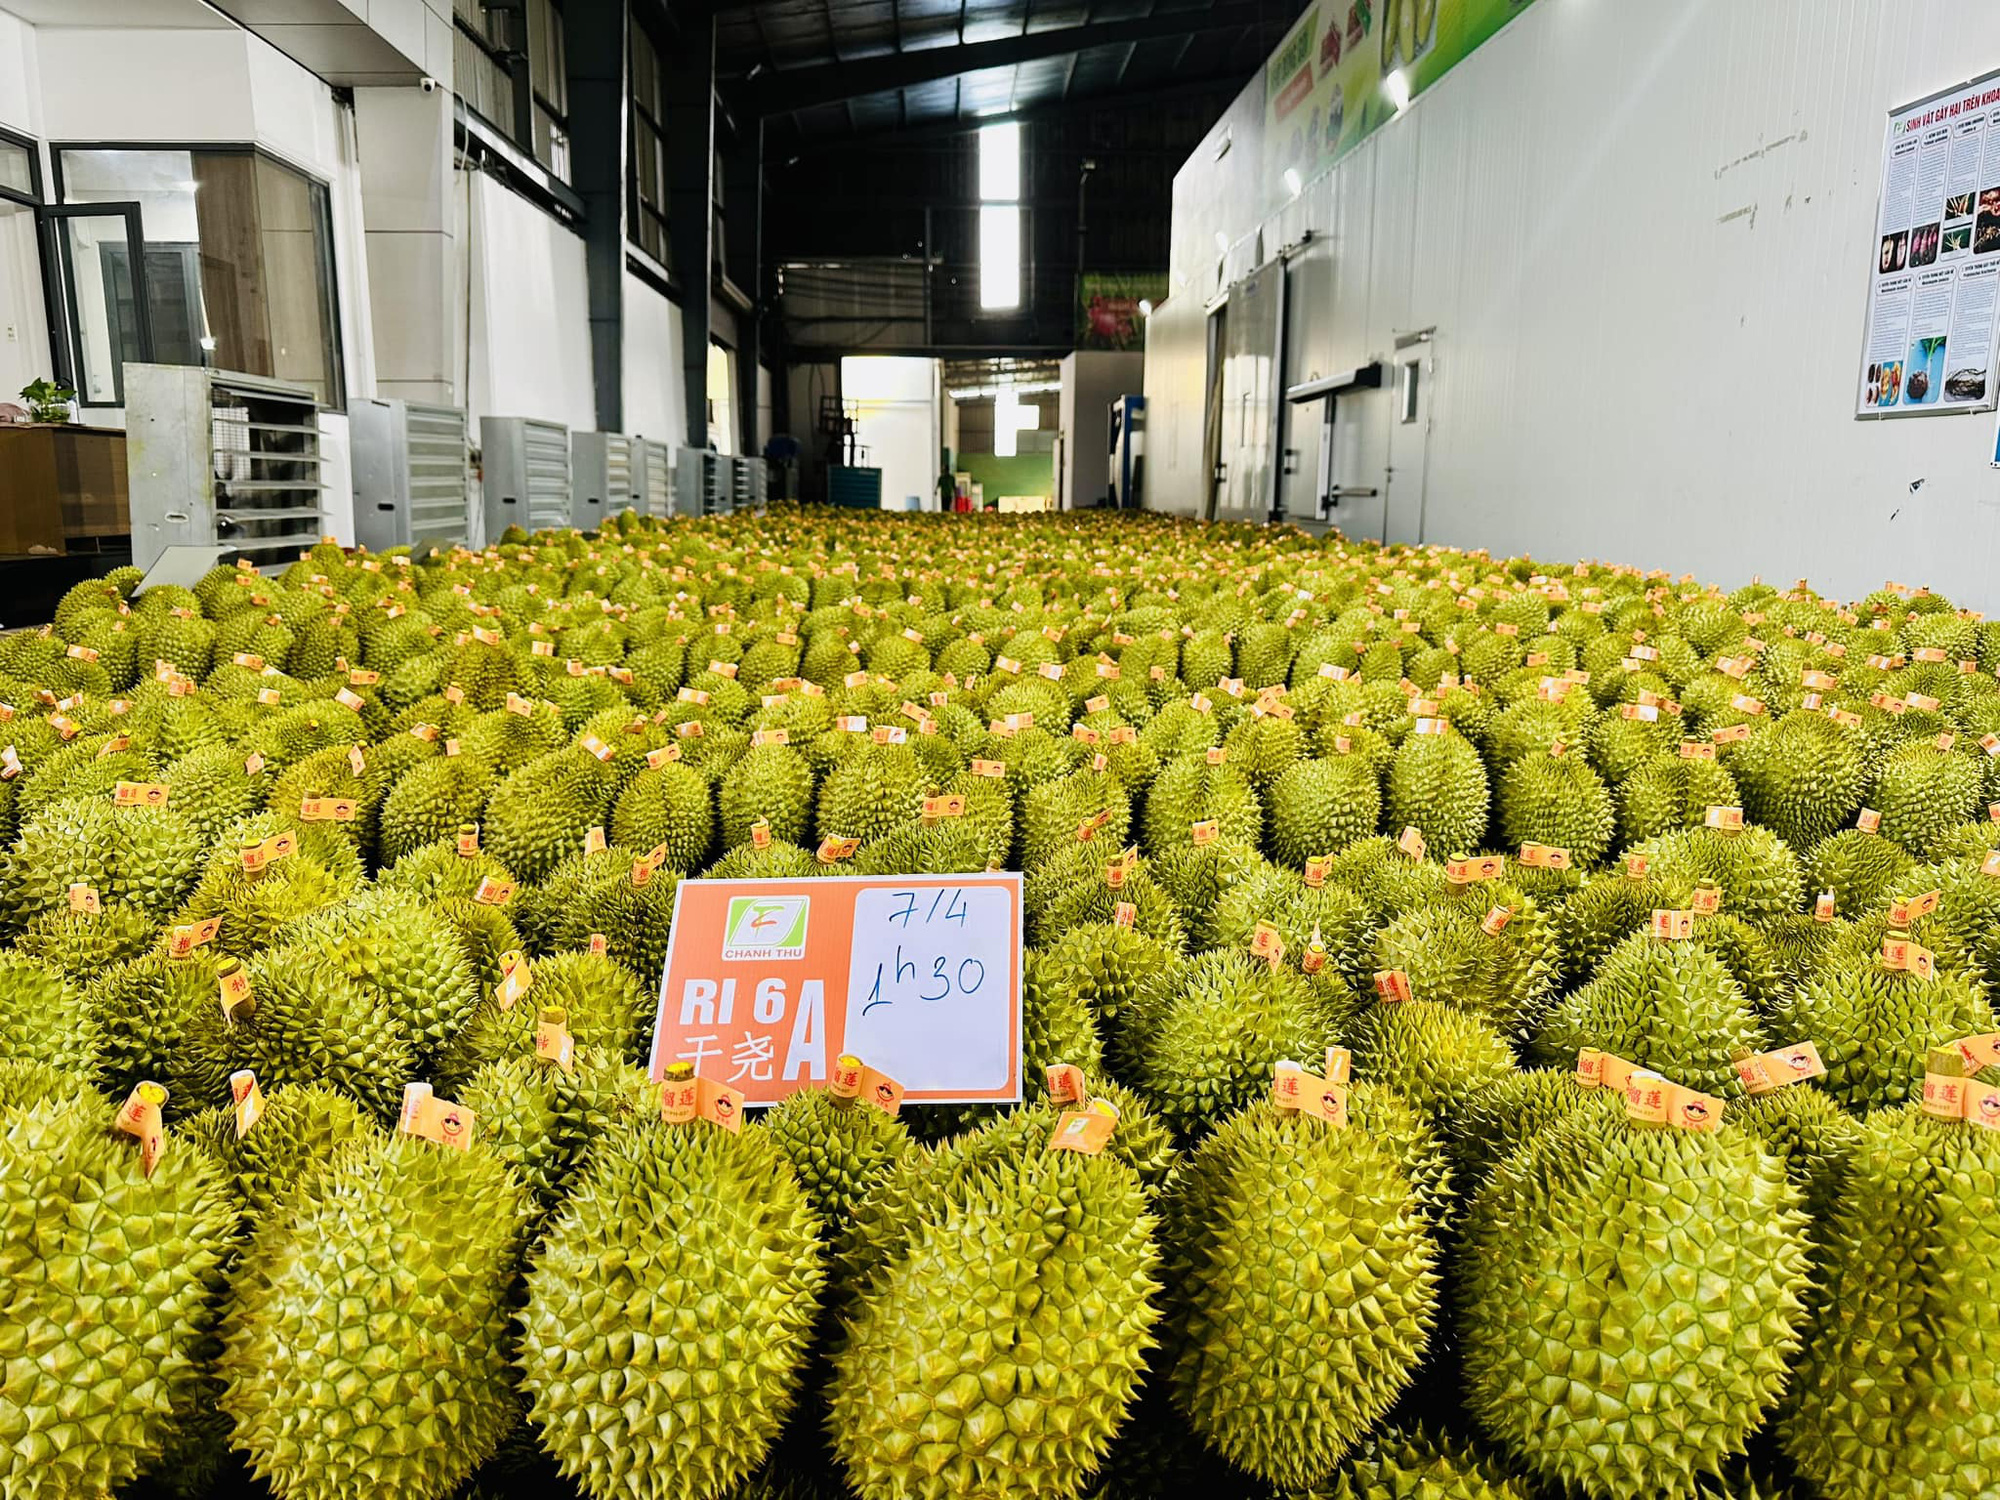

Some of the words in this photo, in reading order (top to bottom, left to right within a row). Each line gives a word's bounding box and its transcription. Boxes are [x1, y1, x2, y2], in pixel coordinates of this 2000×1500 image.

[1906, 116, 1921, 133] SINH
[1922, 112, 1934, 129] VẬT
[1935, 105, 1948, 122] GÂY
[1949, 101, 1961, 119] HẠI
[1963, 94, 1980, 112] TRÊN
[889, 889, 967, 928] 7/4
[725, 948, 772, 959] CHANH
[776, 947, 802, 958] THU
[679, 978, 737, 1025] RI
[753, 977, 786, 1024] 6
[782, 979, 826, 1081] A
[676, 1031, 774, 1084] 干尧
